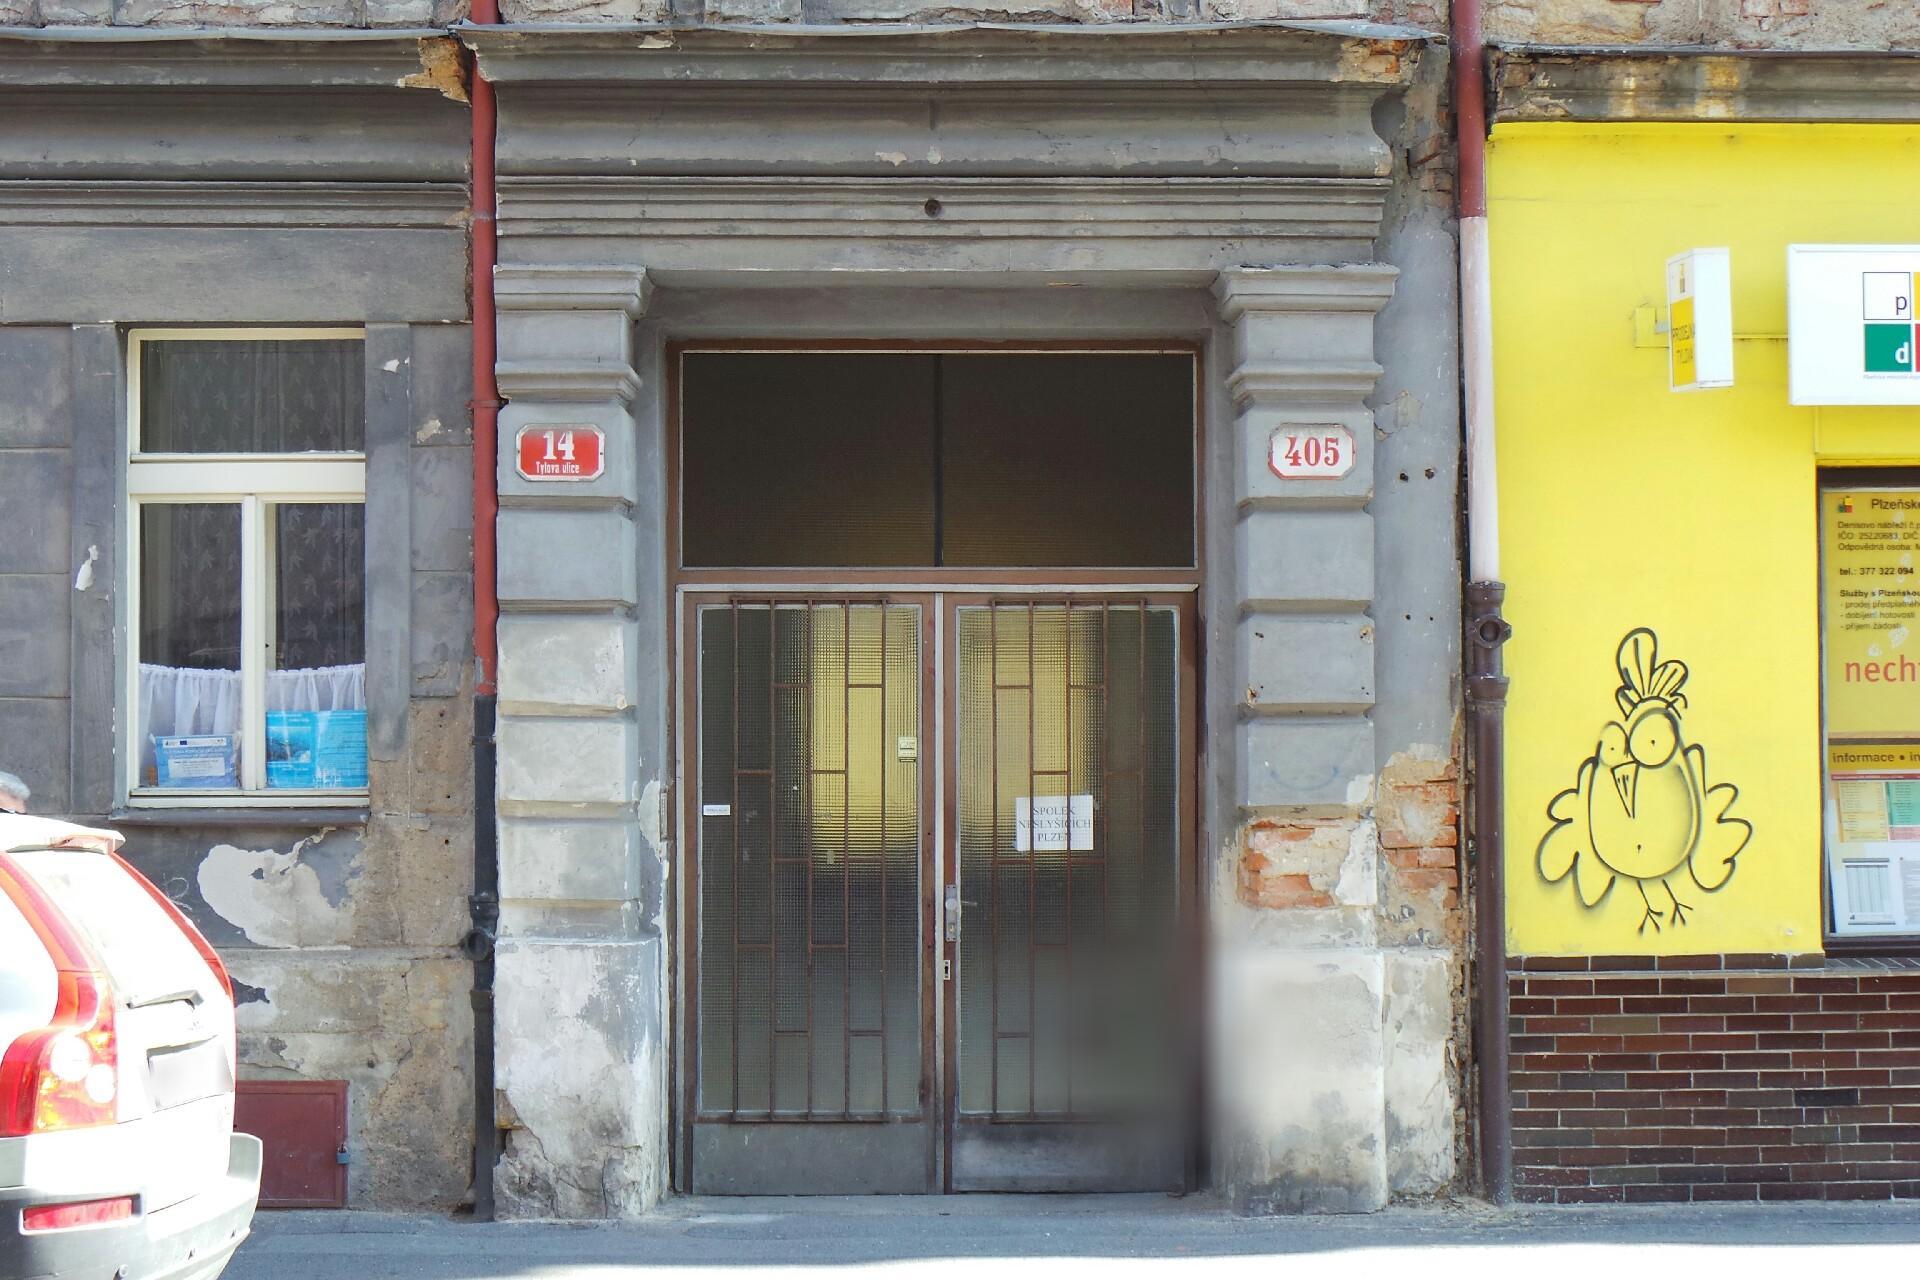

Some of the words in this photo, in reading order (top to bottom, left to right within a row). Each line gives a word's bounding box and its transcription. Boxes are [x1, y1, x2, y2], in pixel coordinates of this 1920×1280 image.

[1895, 296, 1907, 315] p
[1895, 341, 1909, 364] d
[543, 430, 576, 461] 14
[1284, 436, 1340, 467] 405
[536, 461, 560, 475] Tylova
[562, 461, 580, 474] ulice
[1859, 567, 1876, 575] 377
[1879, 567, 1895, 575] 322
[1897, 567, 1914, 575] 094
[1839, 589, 1869, 599] Služby
[1845, 654, 1920, 682] nech
[1833, 752, 1895, 763] informace
[1038, 831, 1072, 842] PLZE
